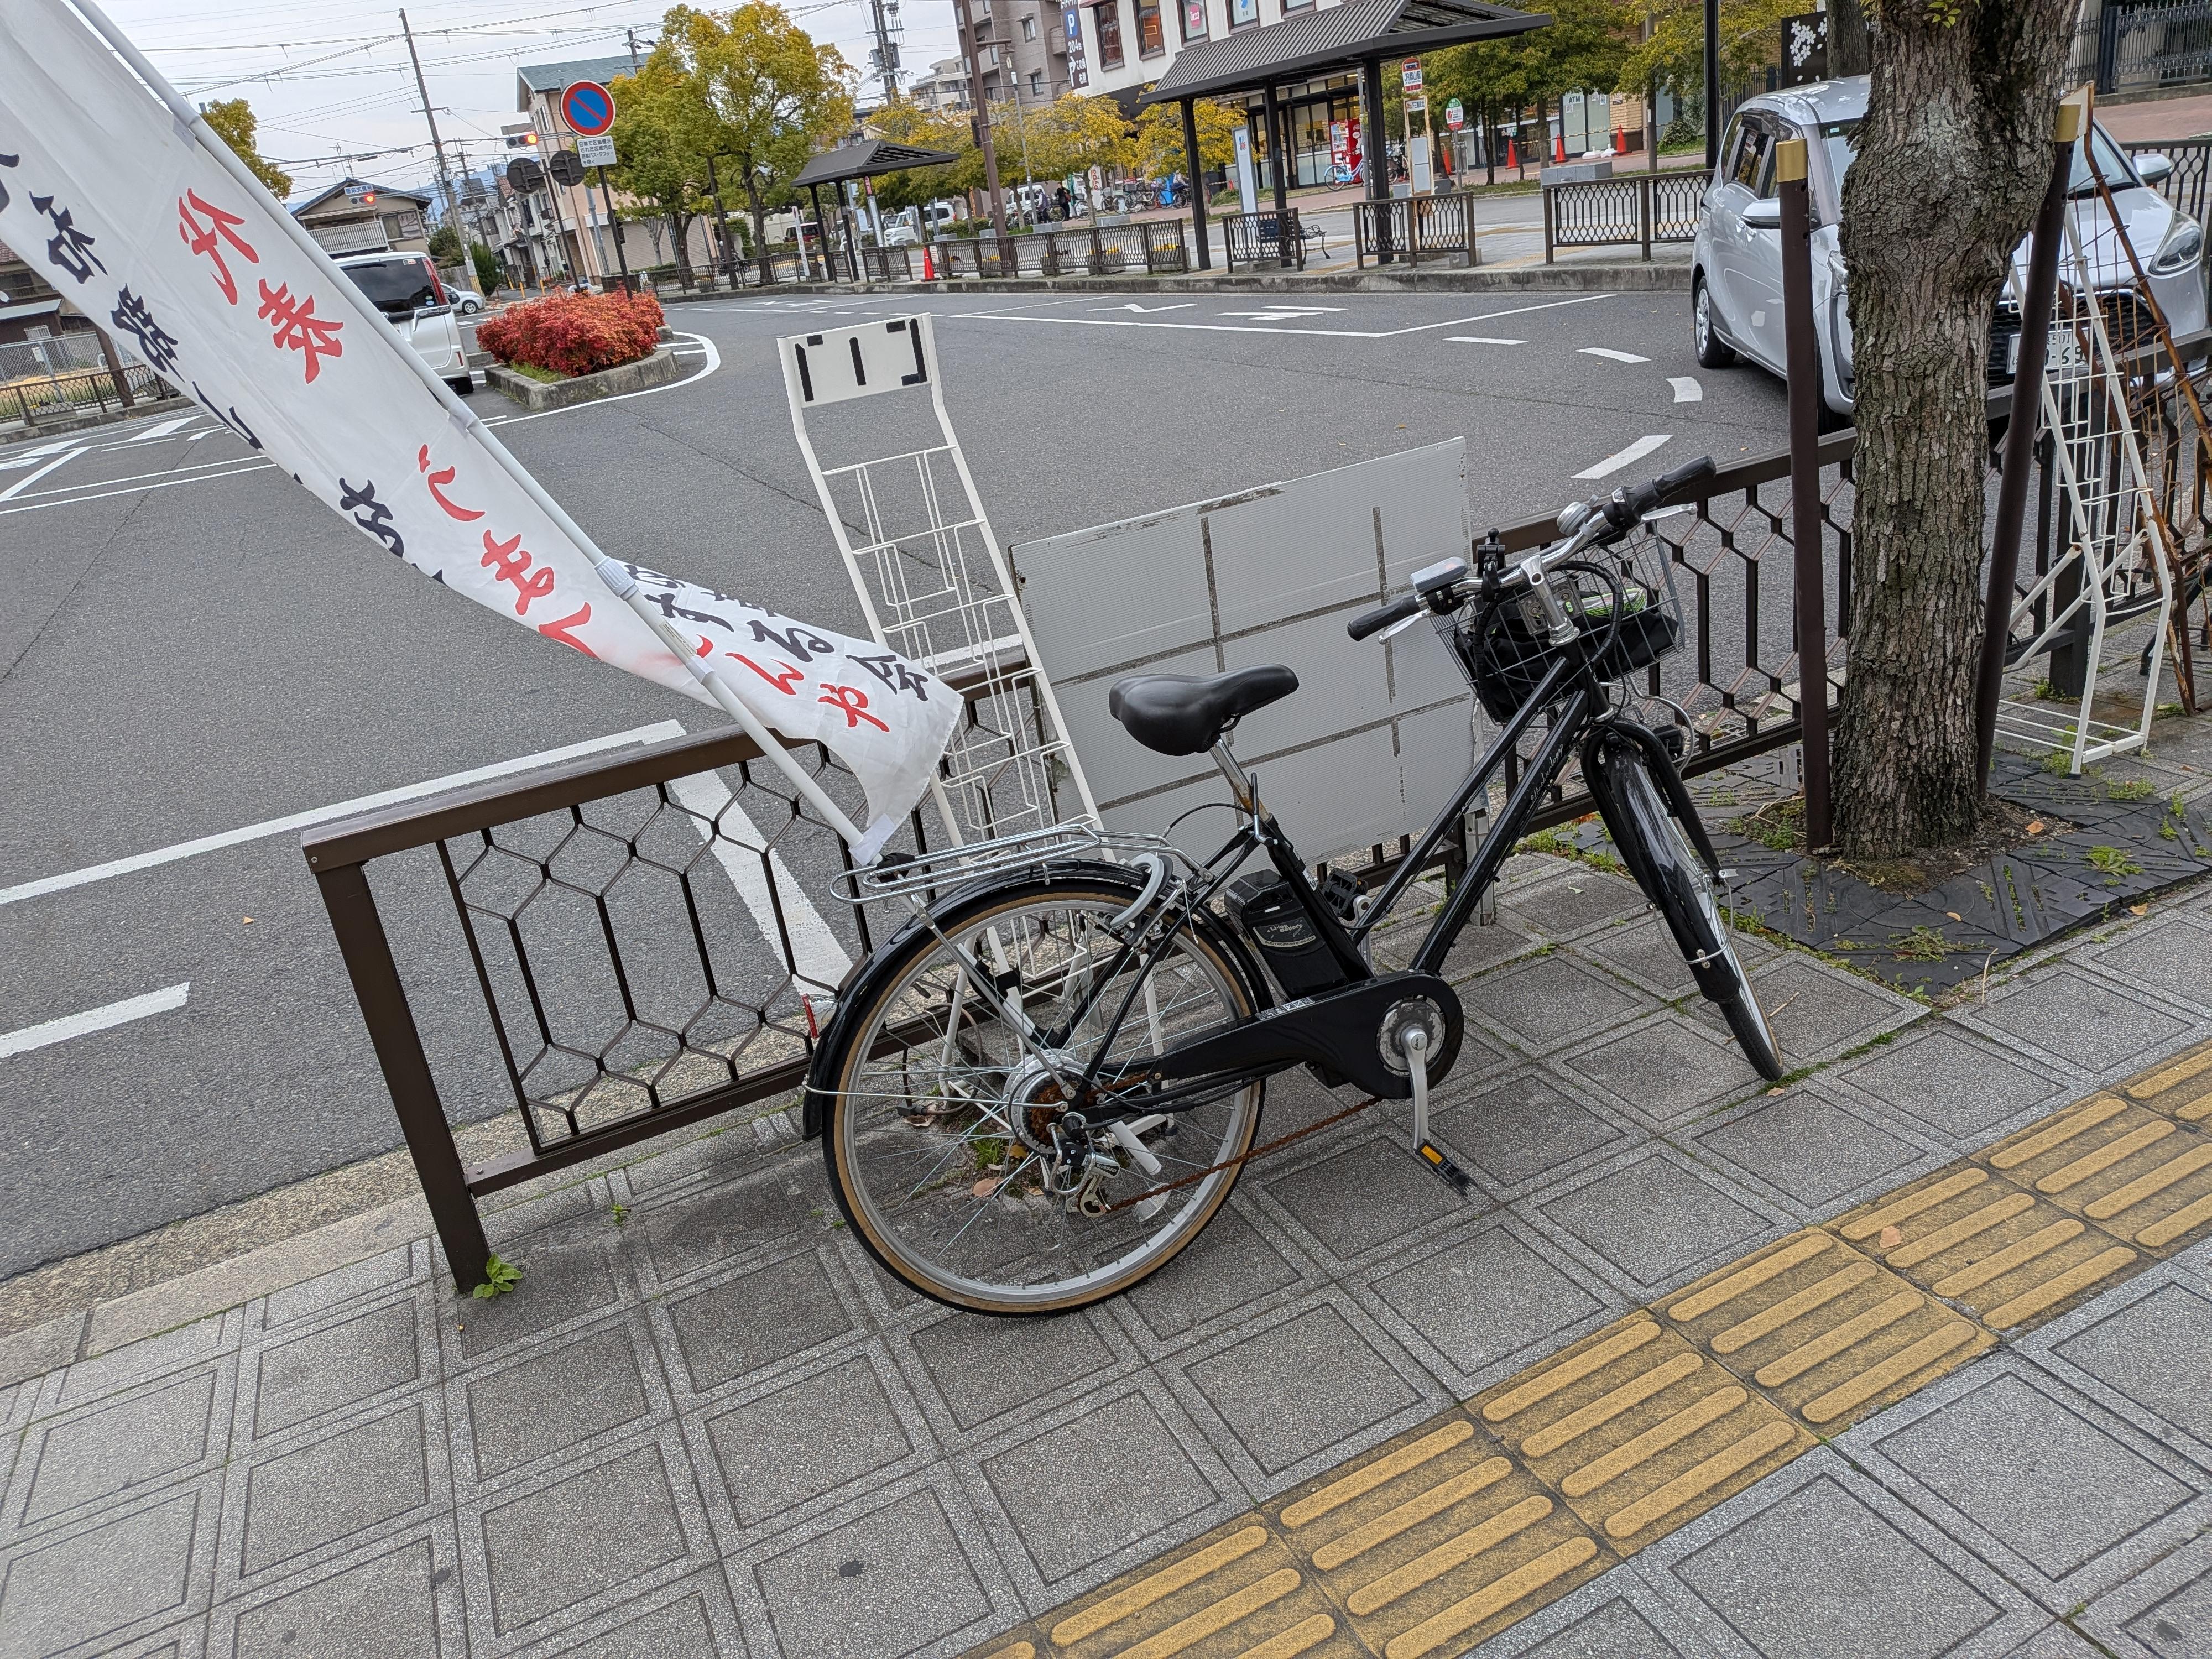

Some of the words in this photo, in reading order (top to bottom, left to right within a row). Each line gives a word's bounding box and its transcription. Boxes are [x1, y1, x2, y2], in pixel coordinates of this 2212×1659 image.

[1067, 13, 1075, 35] P
[1068, 39, 1082, 54] 204台
[1568, 95, 1580, 104] ATM
[1096, 1164, 1117, 1172] SHIMANO
